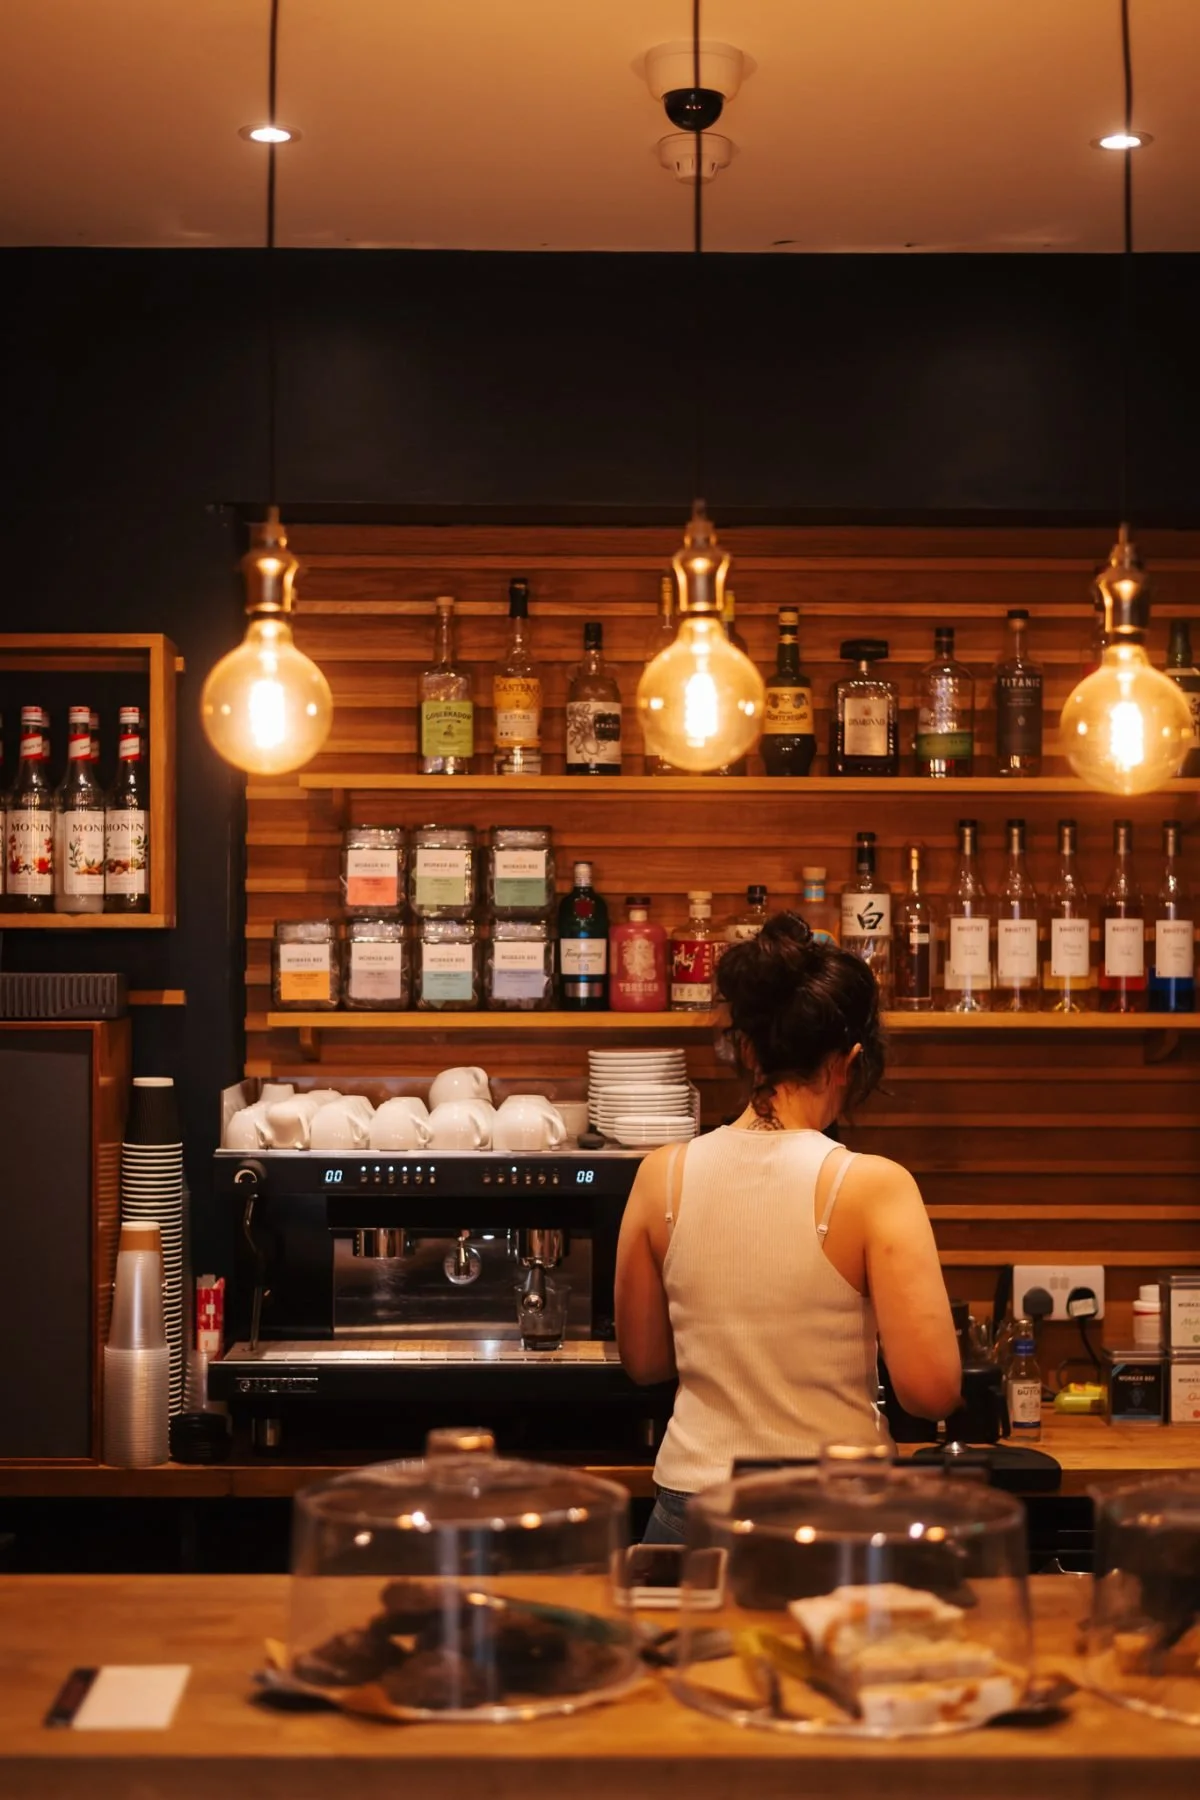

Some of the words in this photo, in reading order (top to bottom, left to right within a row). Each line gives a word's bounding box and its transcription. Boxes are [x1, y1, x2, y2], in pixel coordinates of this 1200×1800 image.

[11, 822, 52, 832] MONIN
[72, 823, 104, 832] MONI
[105, 822, 144, 832] MONIN
[856, 901, 884, 930] 白
[325, 1170, 343, 1183] 00
[576, 1170, 594, 1183] 08
